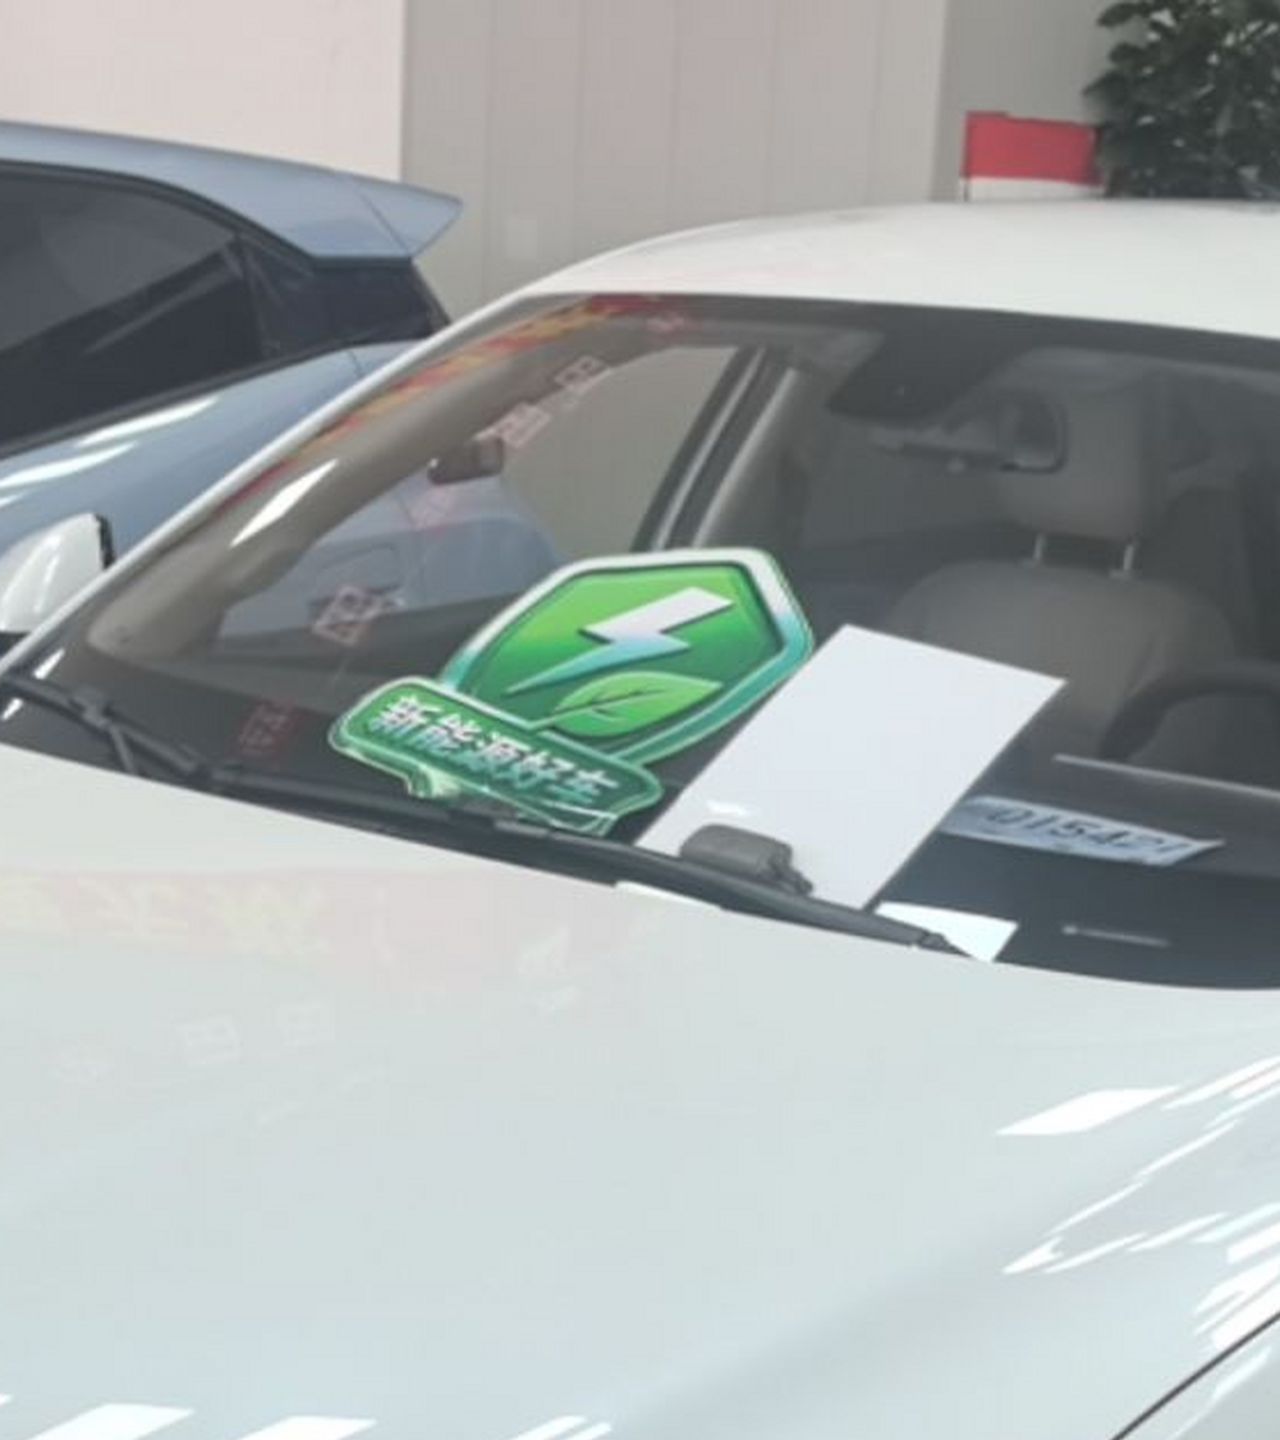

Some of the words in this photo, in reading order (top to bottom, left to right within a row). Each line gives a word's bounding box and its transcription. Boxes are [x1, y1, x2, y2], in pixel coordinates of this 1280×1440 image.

[371, 695, 619, 804] 新能源好车
